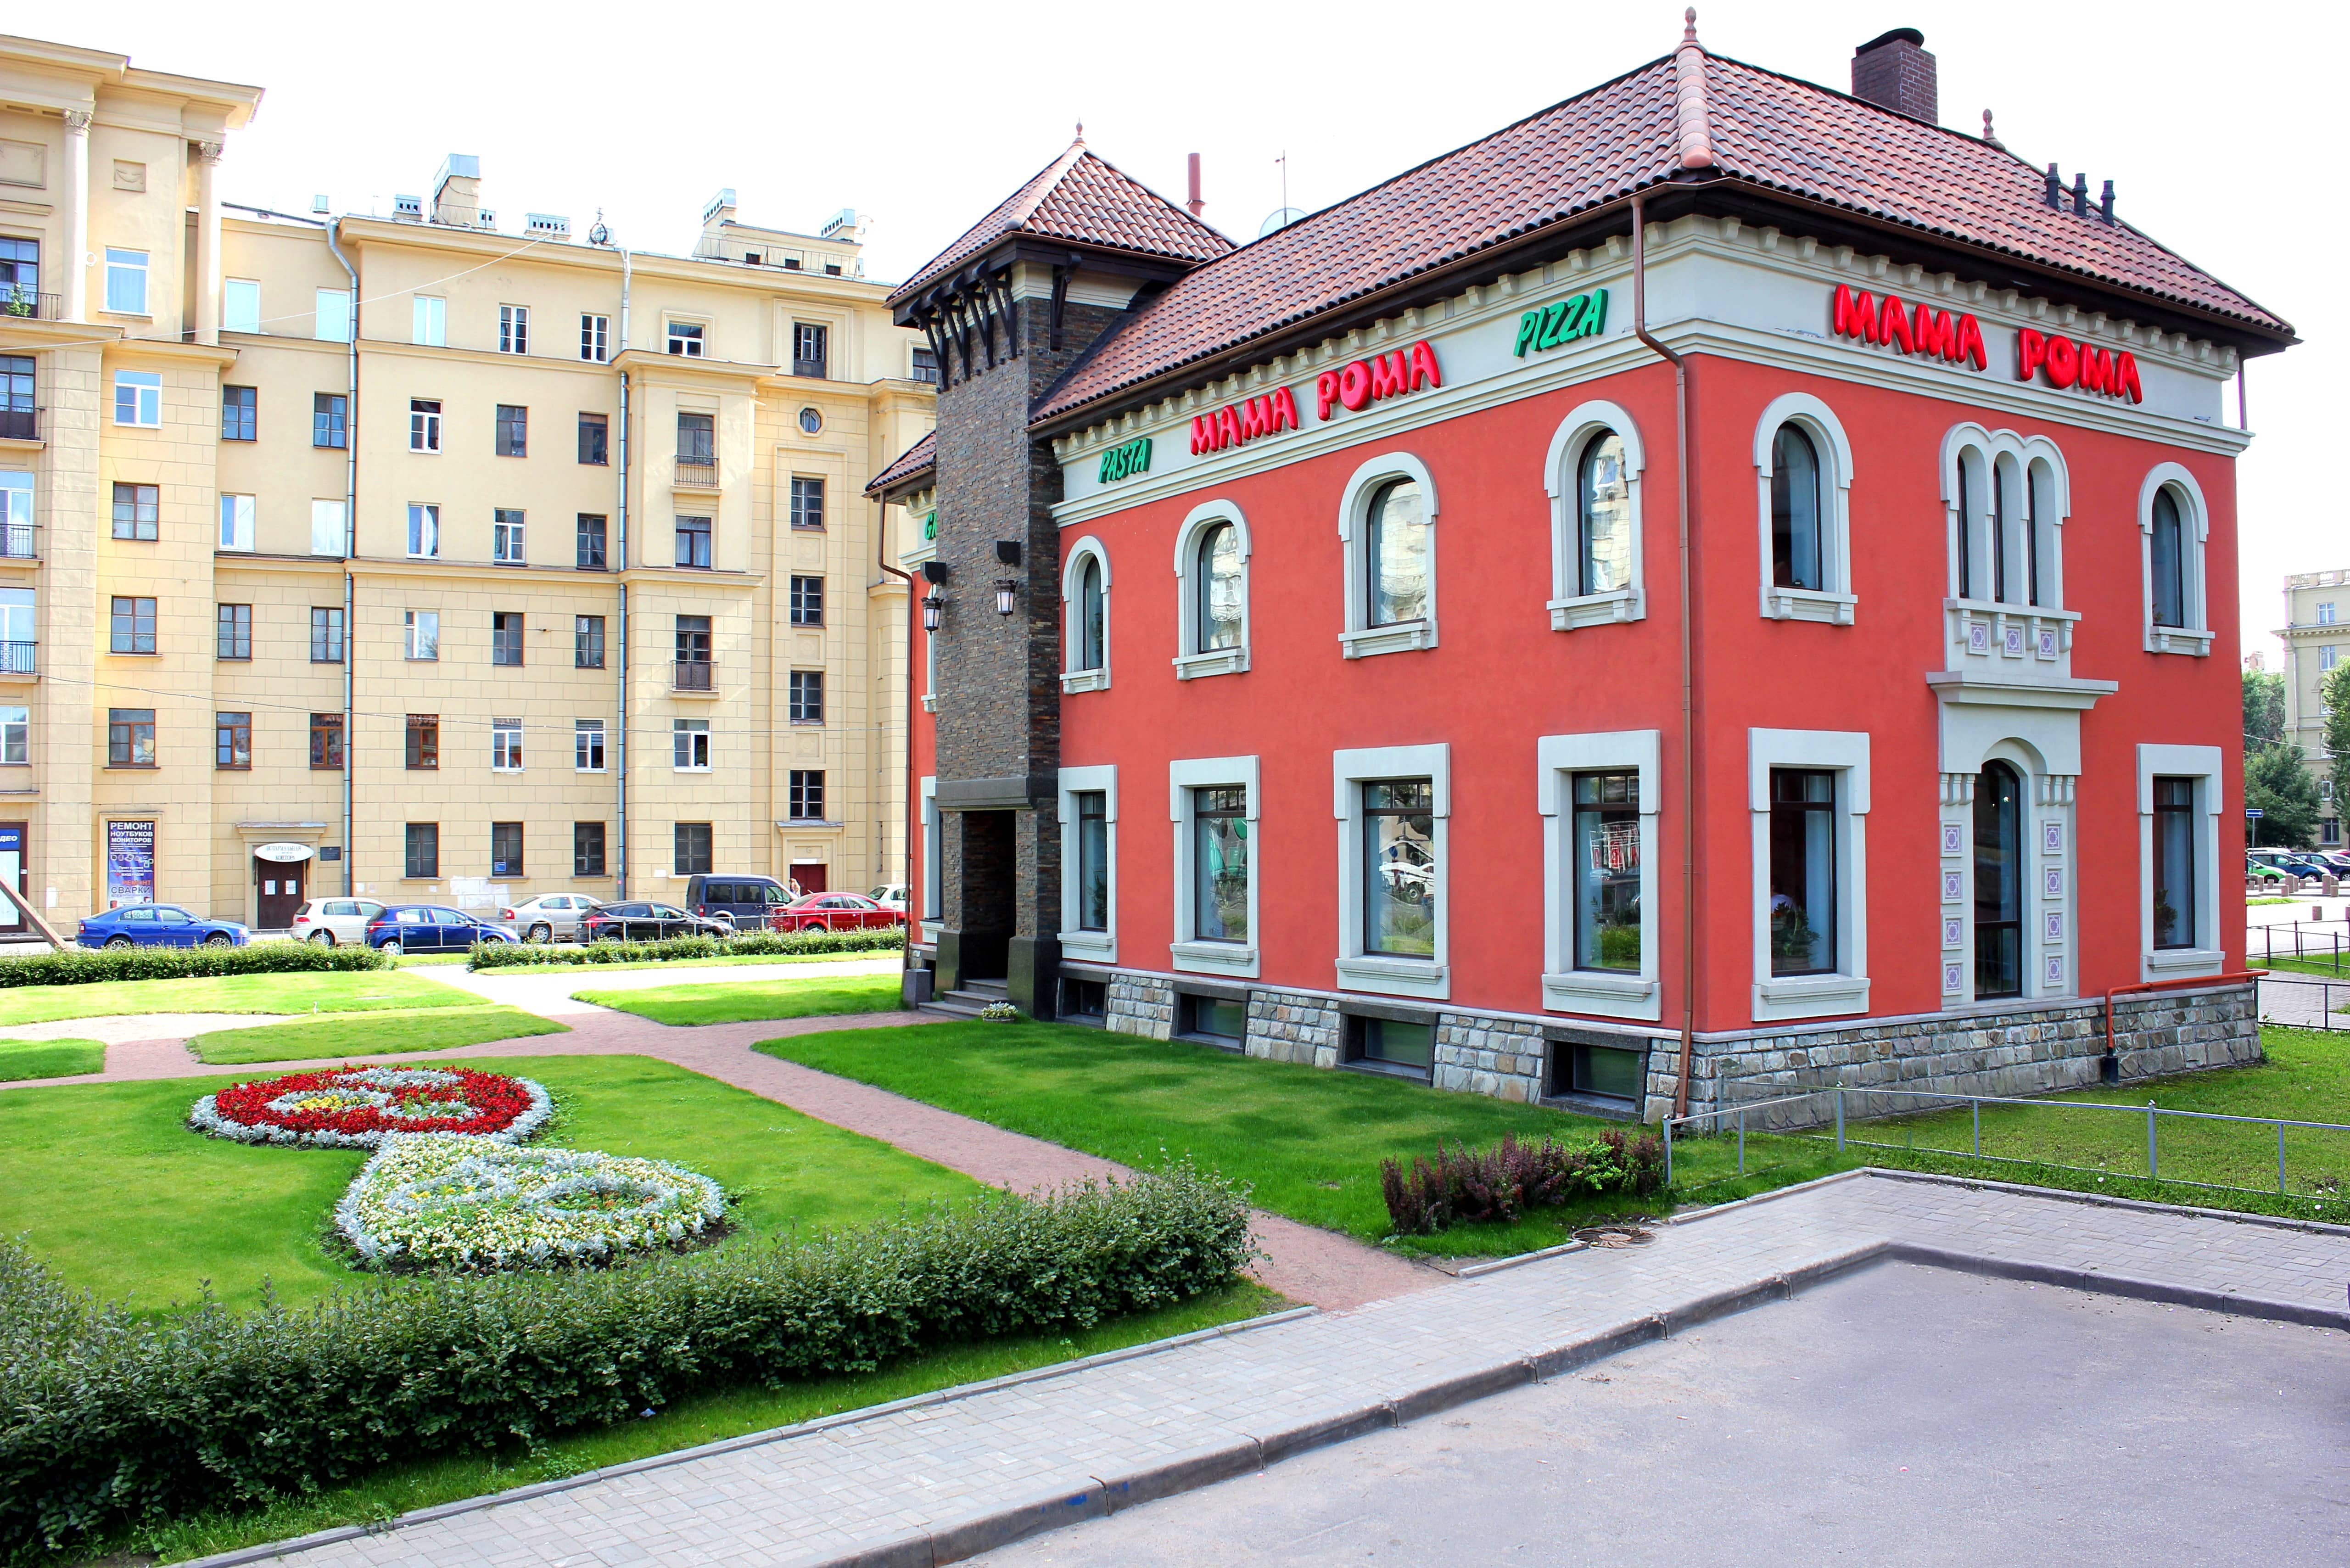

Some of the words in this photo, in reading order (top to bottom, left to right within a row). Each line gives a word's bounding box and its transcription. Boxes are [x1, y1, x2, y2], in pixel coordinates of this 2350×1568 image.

[1513, 288, 1608, 358] PIZZA
[1833, 283, 1987, 371] МАМА
[2019, 328, 2143, 404] РОМА
[1190, 386, 1298, 456] МАМА
[1317, 340, 1441, 421] РОМА
[1098, 438, 1152, 483] PASTA
